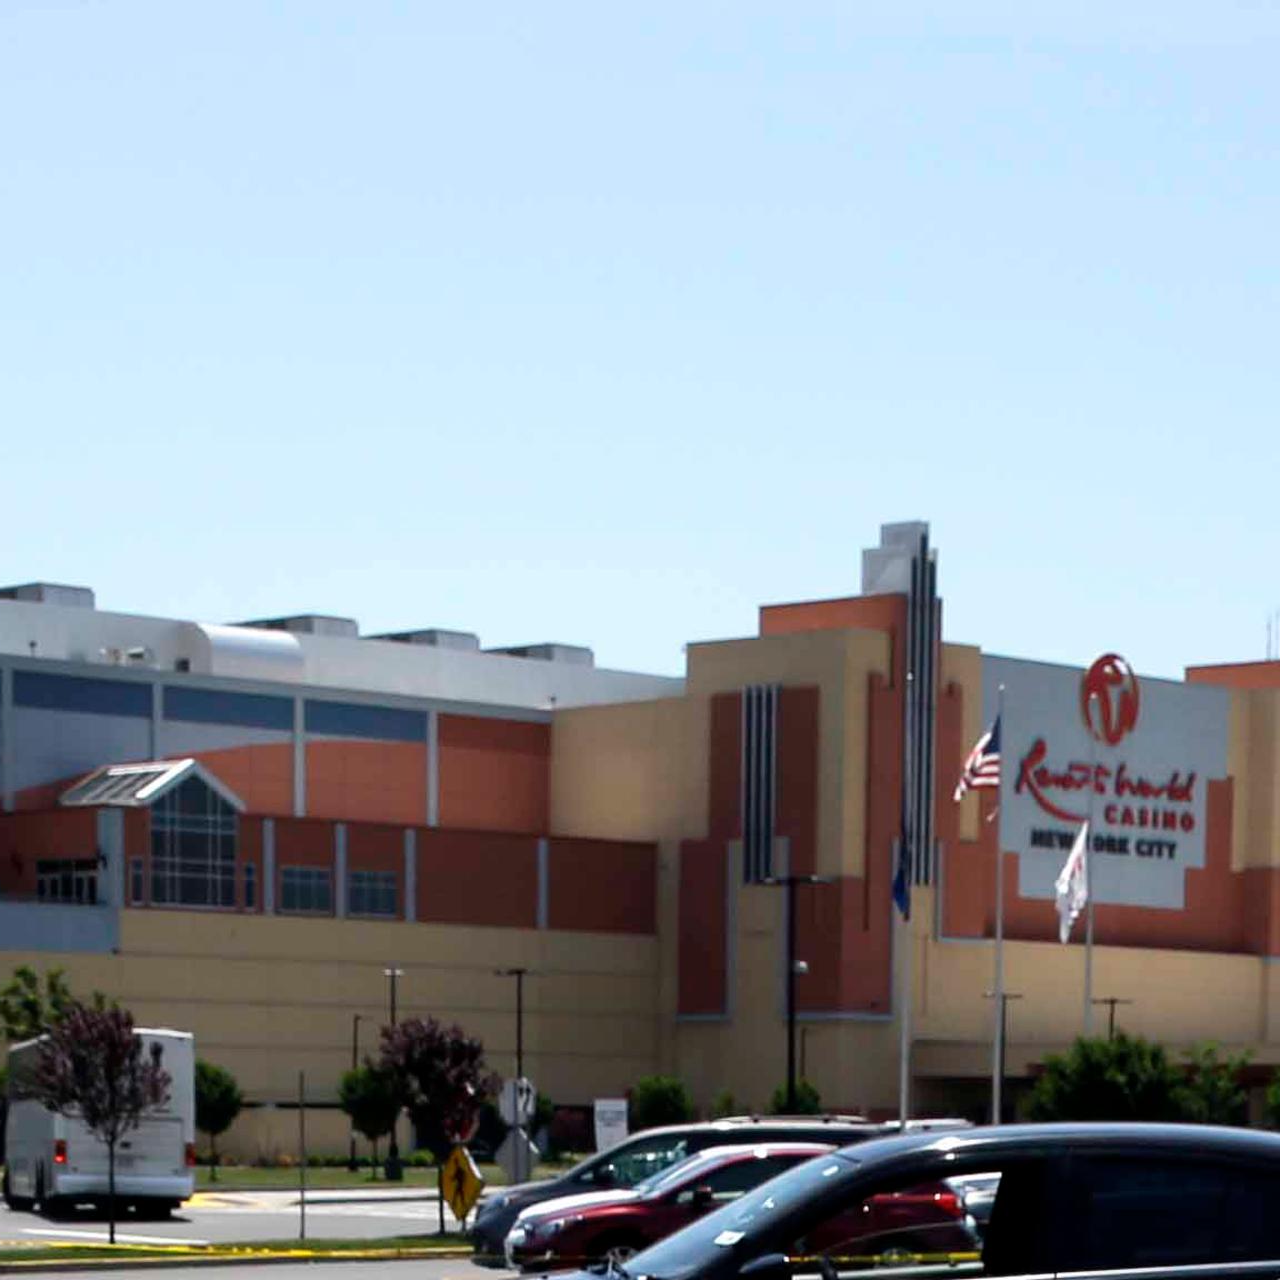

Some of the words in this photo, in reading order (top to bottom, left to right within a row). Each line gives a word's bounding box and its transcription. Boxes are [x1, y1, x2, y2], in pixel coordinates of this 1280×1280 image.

[1105, 804, 1195, 833] CASINO
[1086, 832, 1130, 856] ORK
[1135, 839, 1177, 859] CITY
